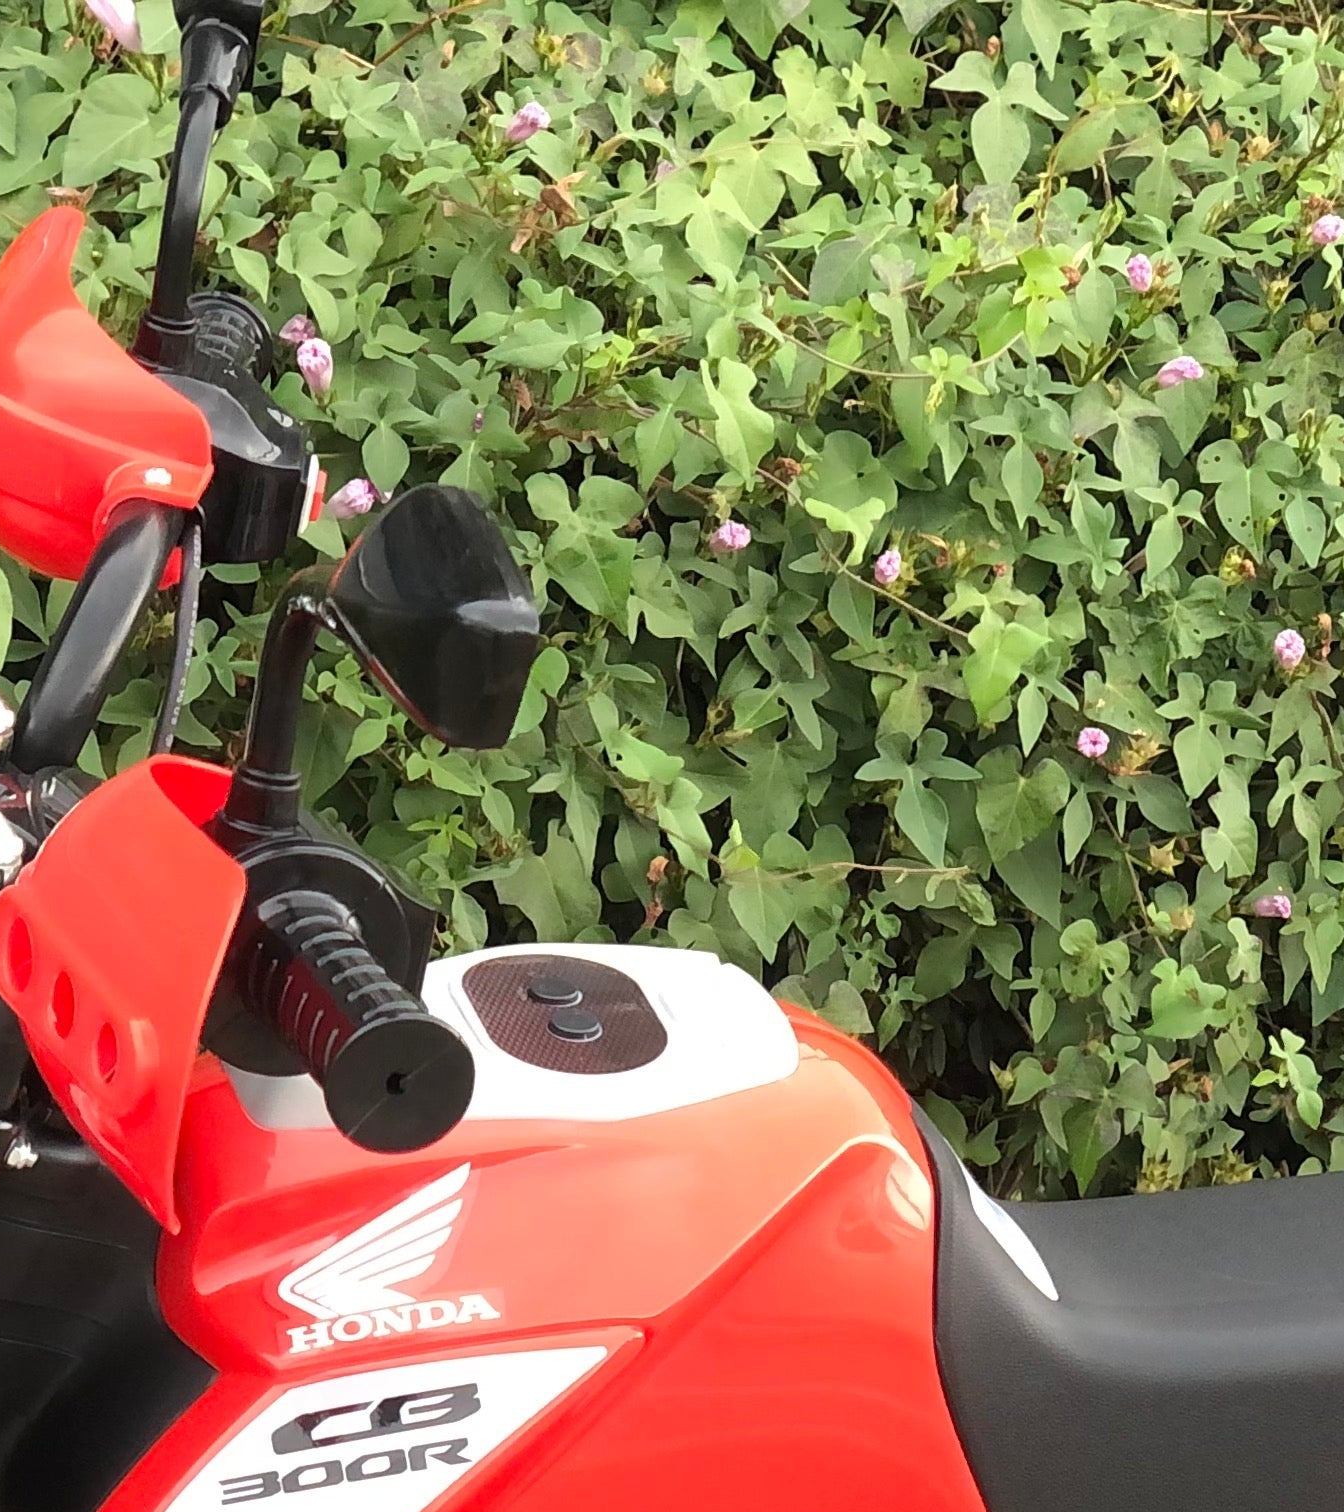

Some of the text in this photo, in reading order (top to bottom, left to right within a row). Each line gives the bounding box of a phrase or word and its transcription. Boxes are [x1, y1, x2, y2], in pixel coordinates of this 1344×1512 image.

[287, 1294, 500, 1353] HONDA
[271, 1382, 482, 1455] CB
[218, 1436, 472, 1505] 300R
